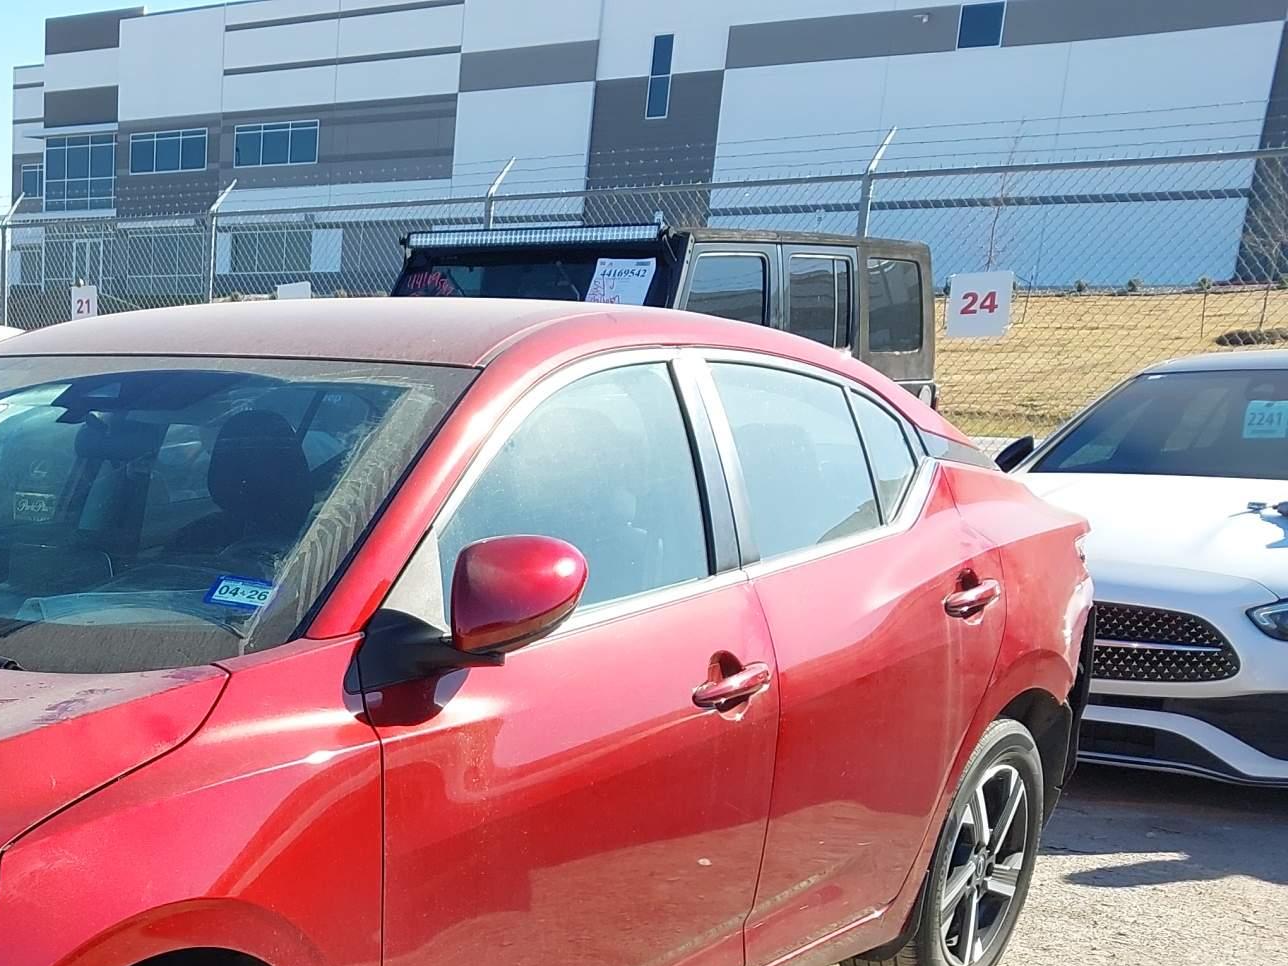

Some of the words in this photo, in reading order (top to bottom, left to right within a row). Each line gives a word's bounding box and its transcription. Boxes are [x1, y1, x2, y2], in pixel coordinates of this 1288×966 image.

[600, 268, 647, 278] 44169542
[76, 299, 92, 314] 21
[959, 291, 999, 315] 24
[1247, 411, 1283, 426] 2241
[218, 585, 240, 597] 04
[246, 590, 270, 600] 26
